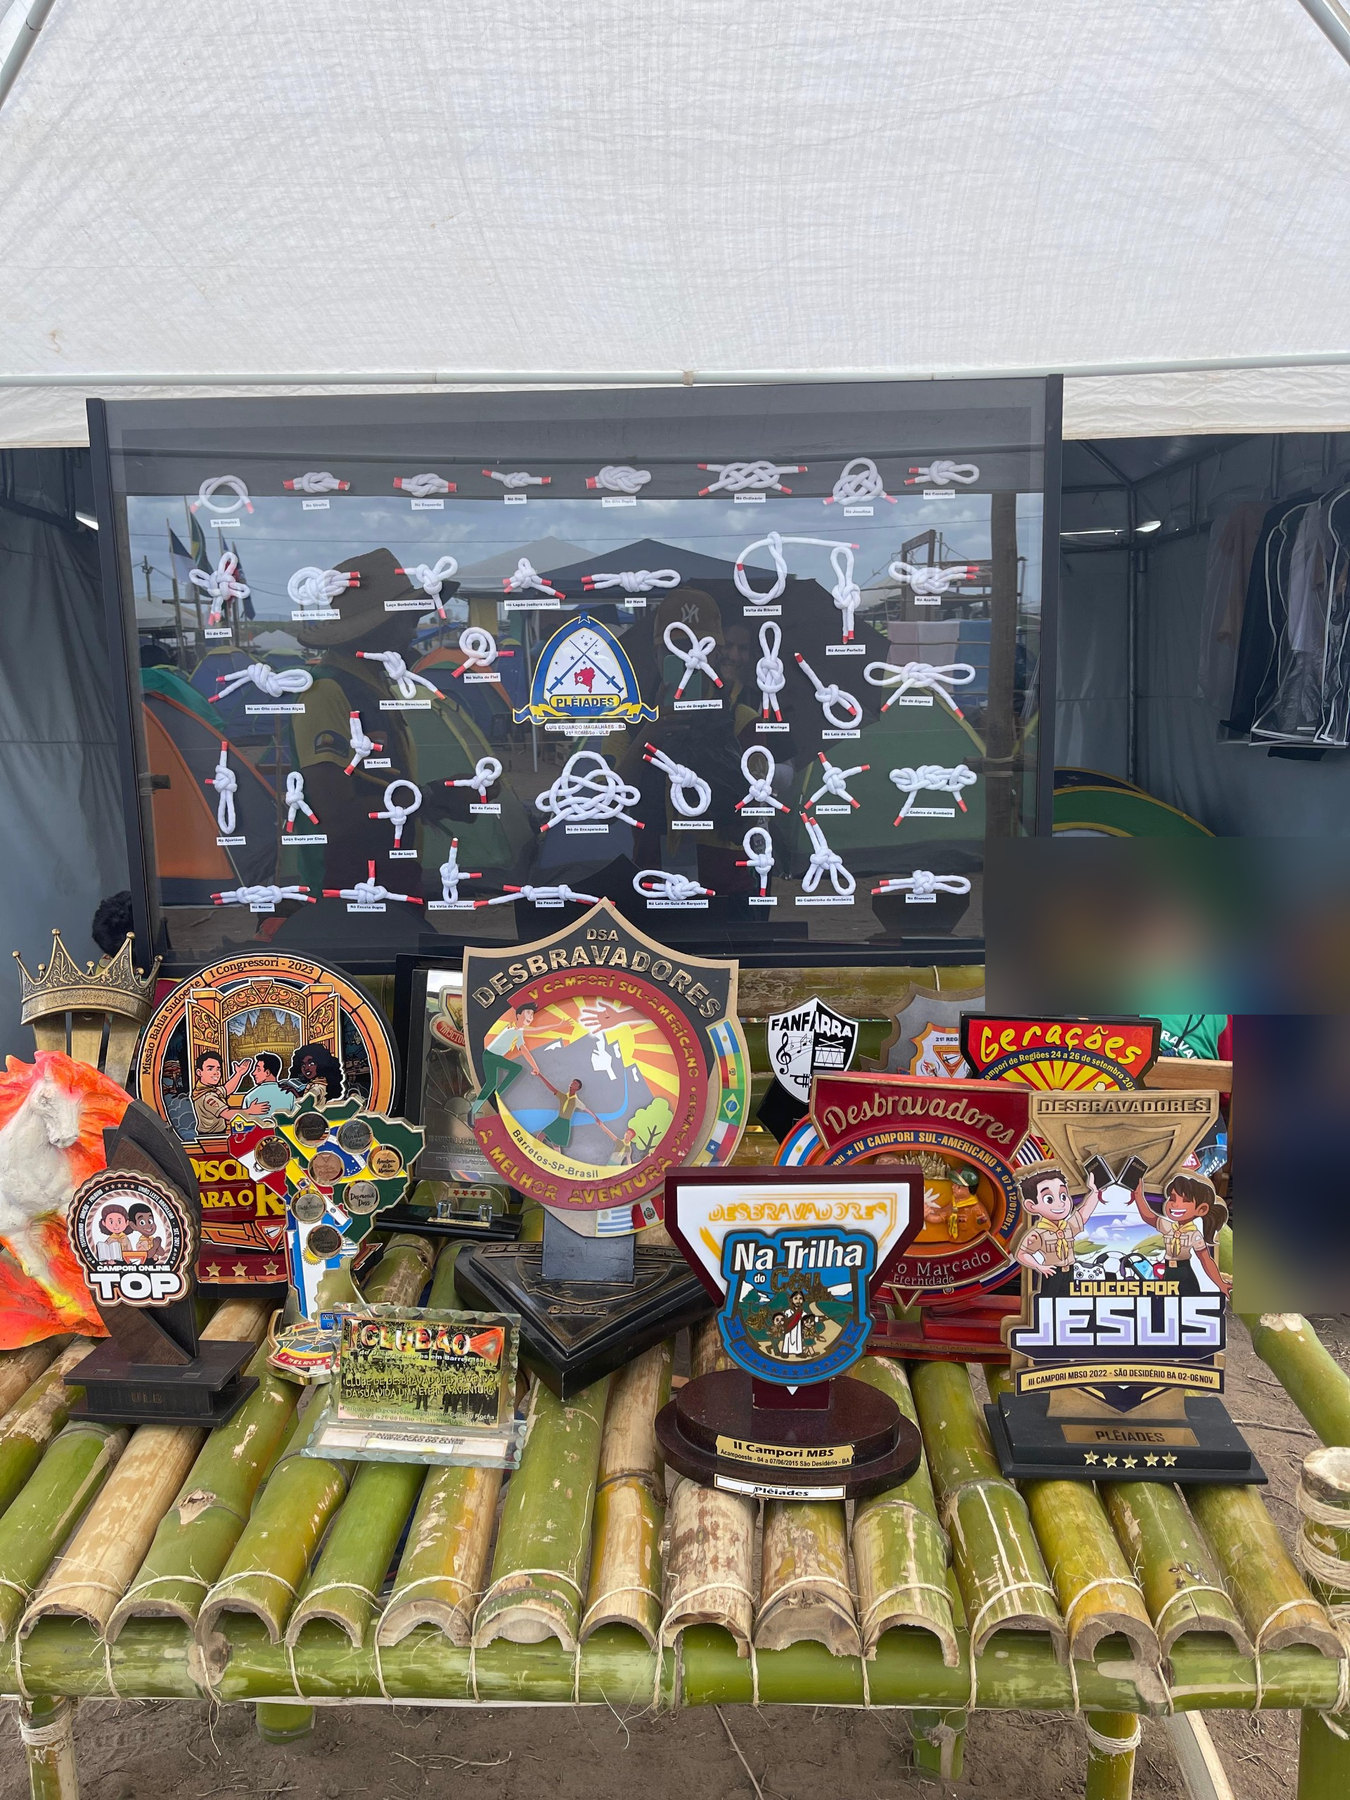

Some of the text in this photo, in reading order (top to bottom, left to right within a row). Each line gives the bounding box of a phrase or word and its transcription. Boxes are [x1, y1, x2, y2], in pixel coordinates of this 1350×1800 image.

[556, 695, 614, 708] PLÊIADES
[586, 928, 619, 942] DSA
[216, 958, 280, 976] Congressori
[288, 961, 315, 975] 2023
[472, 945, 721, 1019] DESBRAVADORES
[528, 990, 539, 1001] V
[142, 980, 202, 1076] Missão Bahia Sudoeste
[771, 1011, 853, 1038] FANFARRA
[980, 1024, 1143, 1065] Gerações
[982, 1060, 1008, 1081] ampori
[1008, 1056, 1019, 1066] de
[1019, 1050, 1050, 1062] Regiões
[1050, 1050, 1061, 1059] 24
[1069, 1052, 1080, 1061] 26
[1081, 1054, 1091, 1063] de
[1091, 1058, 1124, 1079] setembro
[1122, 1076, 1137, 1092] 201
[1038, 1098, 1212, 1113] DESBRAVADORES
[823, 1092, 1016, 1145] Desbravadores
[512, 1129, 599, 1179] Barretos-SP-Brasil
[853, 1132, 998, 1168] IV CAMPORI SUL-AMERICANO
[489, 1145, 559, 1200] MELHOR
[568, 1156, 673, 1205] AVENTURA
[1001, 1175, 1008, 1185] 07
[238, 1190, 254, 1206] O
[708, 1202, 889, 1222] DESBRAVADORES
[1001, 1191, 1017, 1231] 12/01/2014
[734, 1242, 774, 1272] Na
[784, 1239, 864, 1270] Trilha
[917, 1252, 991, 1277] Marcado
[90, 1272, 180, 1299] TOP
[754, 1273, 766, 1284] do
[1070, 1281, 1180, 1296] LOUCOS POR
[1016, 1296, 1221, 1346] JESUS
[360, 1322, 472, 1356] CLUBÃO
[346, 1377, 373, 1387] CLUBE
[1037, 1373, 1067, 1385] CAMPORI
[1068, 1370, 1088, 1380] MBSO
[1089, 1369, 1108, 1378] 2022
[1114, 1368, 1128, 1377] SÃO
[1129, 1368, 1166, 1379] DESIDÉRIO
[1166, 1370, 1177, 1380] BA
[1178, 1372, 1199, 1382] 02-06
[1200, 1375, 1215, 1385] NOV
[1096, 1430, 1166, 1443] PLÊIADES
[733, 1441, 835, 1458] II Campori MBS
[754, 1487, 809, 1497] Plêiades
